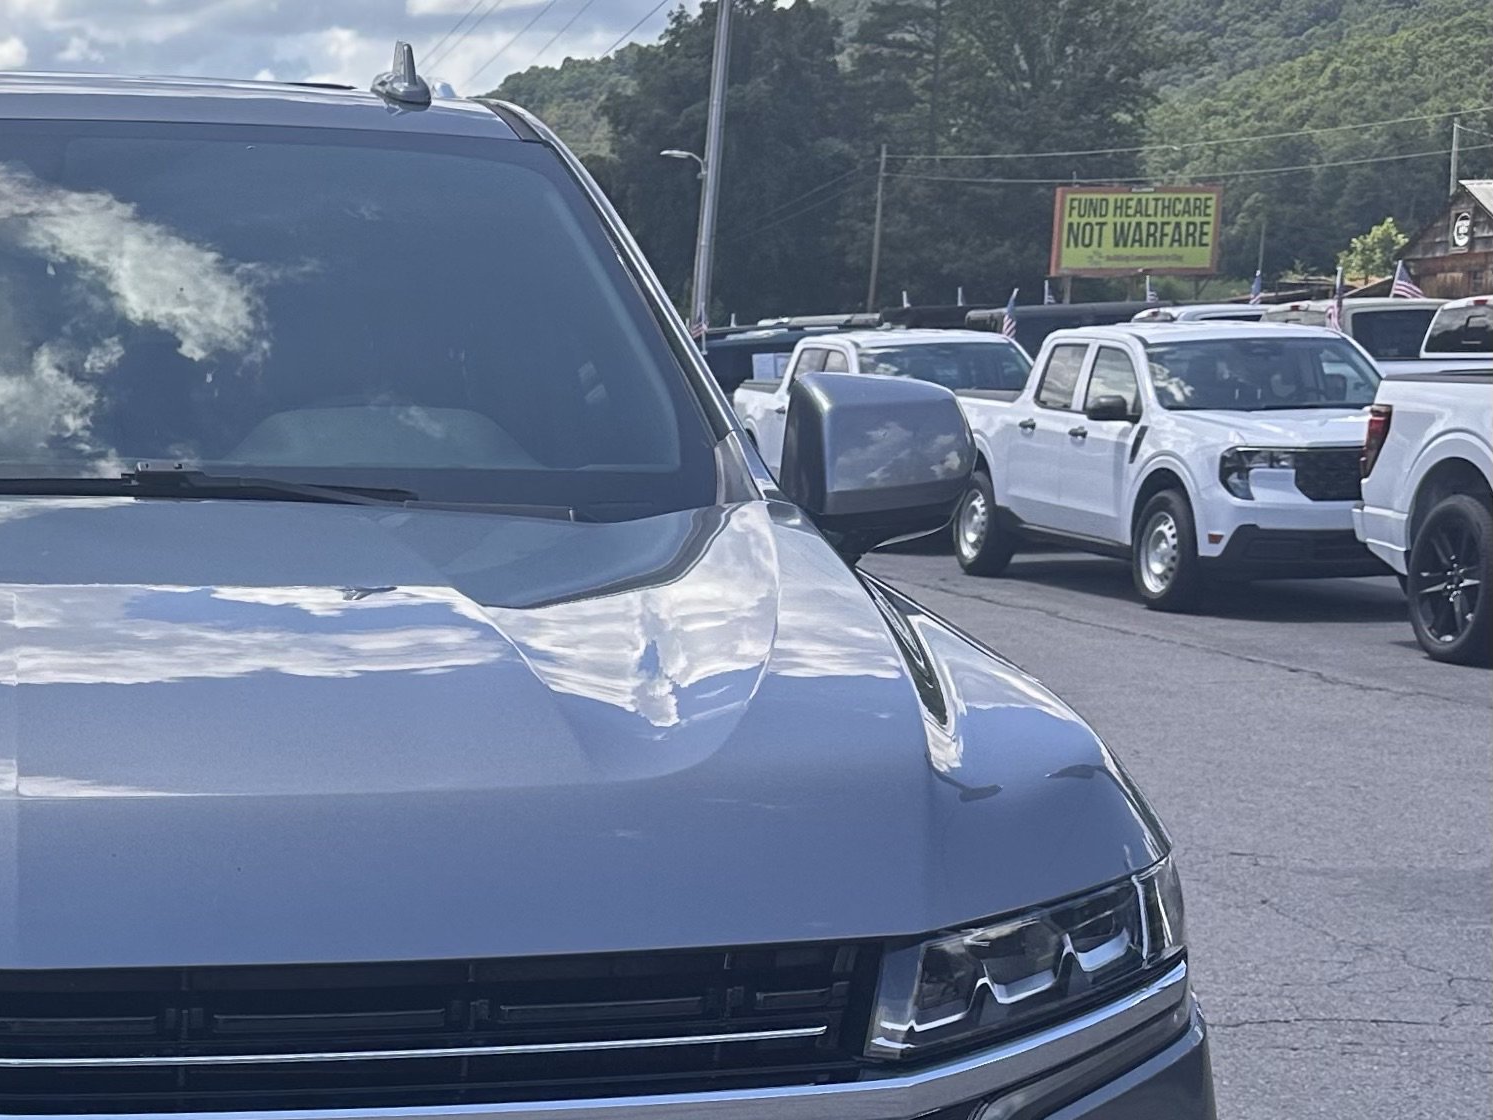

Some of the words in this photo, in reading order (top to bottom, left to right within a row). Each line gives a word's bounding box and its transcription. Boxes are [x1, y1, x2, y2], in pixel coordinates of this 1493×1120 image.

[1068, 198, 1109, 218] FUND
[1113, 197, 1212, 218] HEALTHCARE
[1066, 222, 1107, 248] NOT
[1113, 221, 1210, 248] WARFARE
